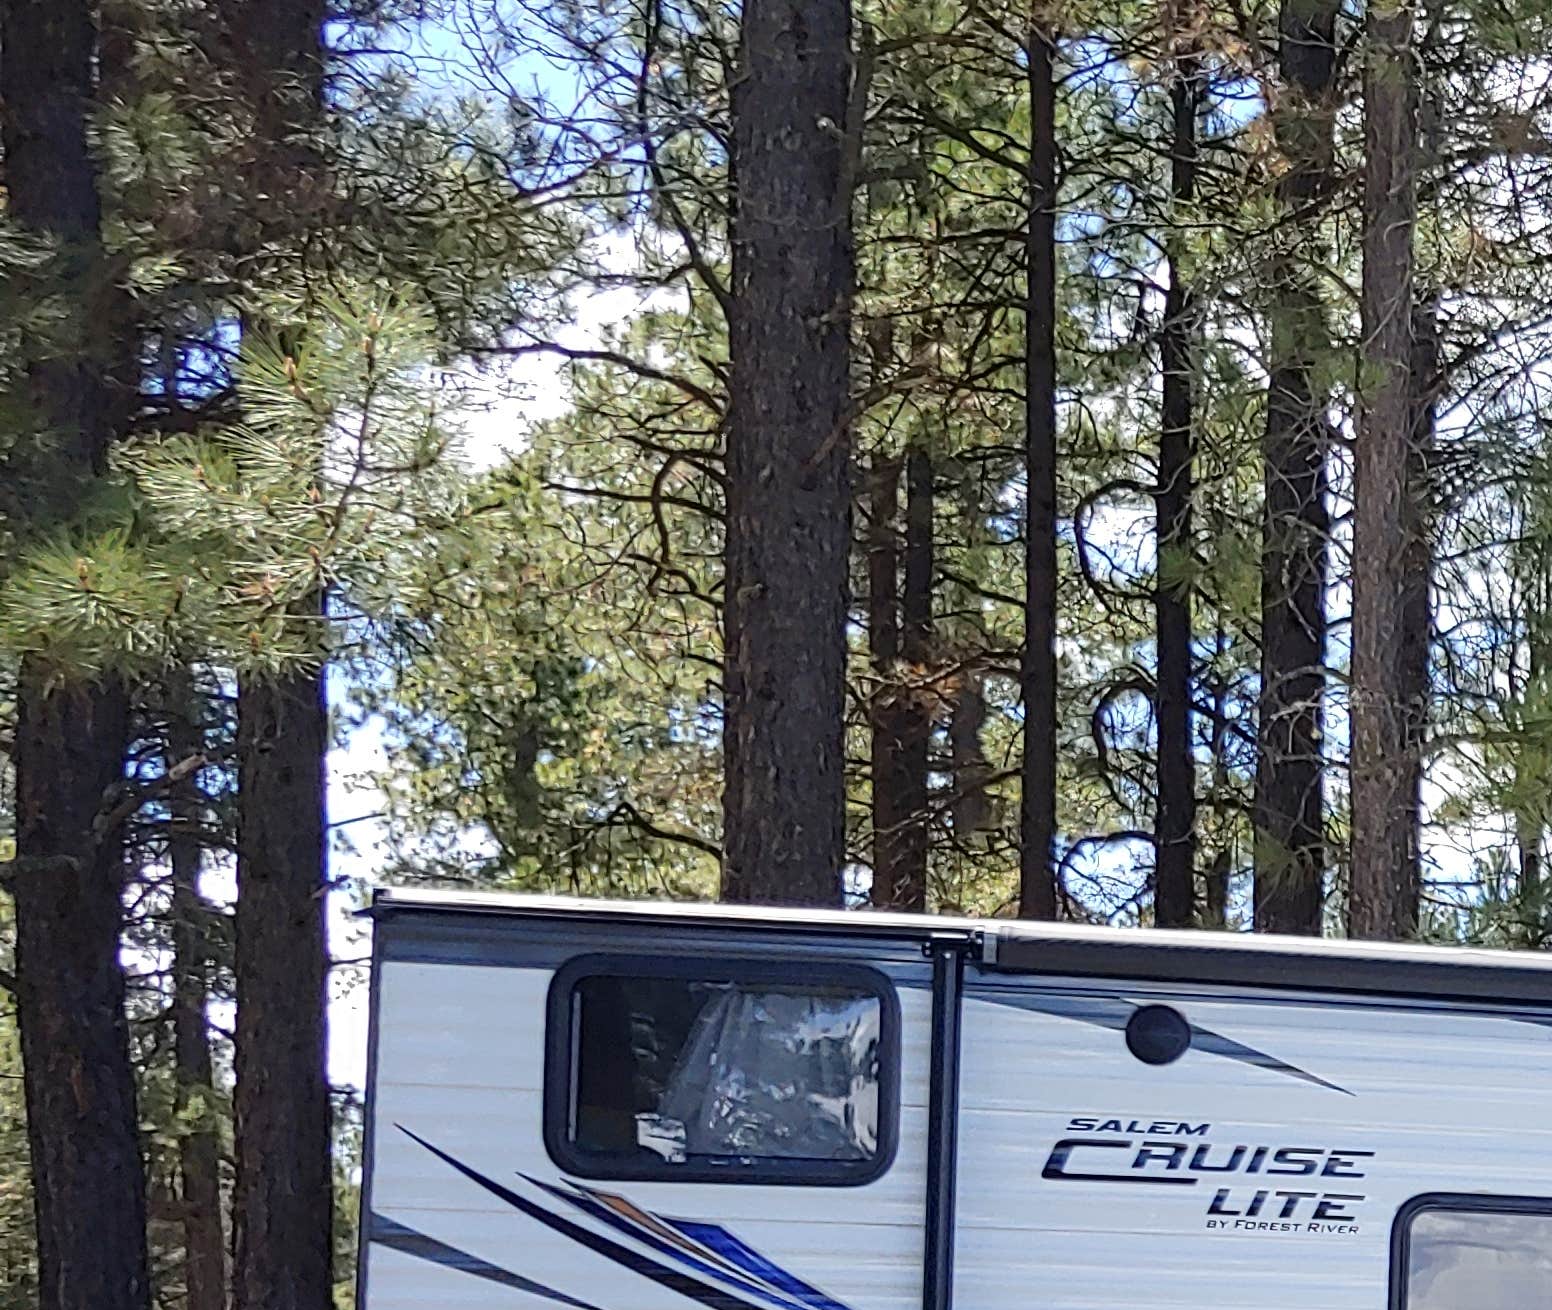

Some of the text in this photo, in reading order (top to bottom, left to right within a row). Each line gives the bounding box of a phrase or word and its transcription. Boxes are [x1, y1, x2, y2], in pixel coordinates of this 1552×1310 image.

[1065, 1118, 1211, 1136] SALEM
[1041, 1138, 1376, 1185] CRUISE
[1206, 1188, 1366, 1222] LITE
[1206, 1219, 1359, 1235] BY FOREST RIVER
